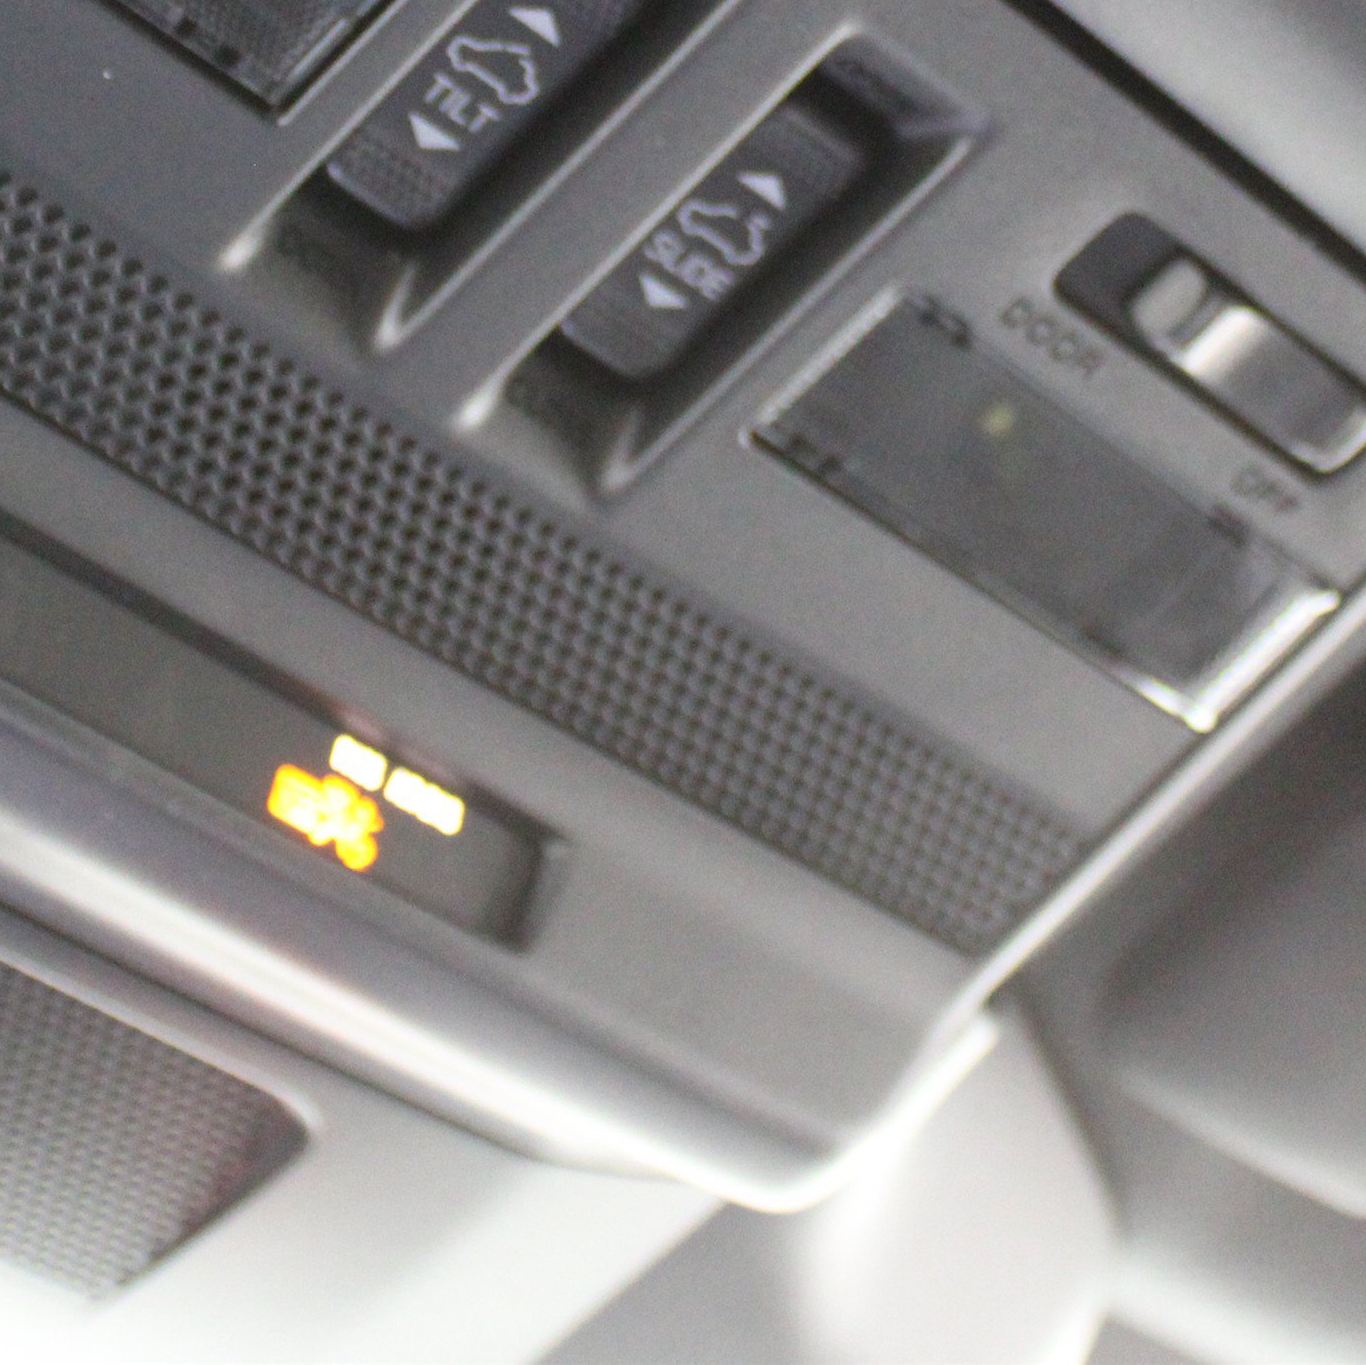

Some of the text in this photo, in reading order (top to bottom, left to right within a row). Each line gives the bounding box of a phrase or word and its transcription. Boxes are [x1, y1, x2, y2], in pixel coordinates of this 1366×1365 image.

[424, 72, 502, 132] TILT
[641, 233, 734, 302] SLIDE
[999, 295, 1106, 377] DOOR
